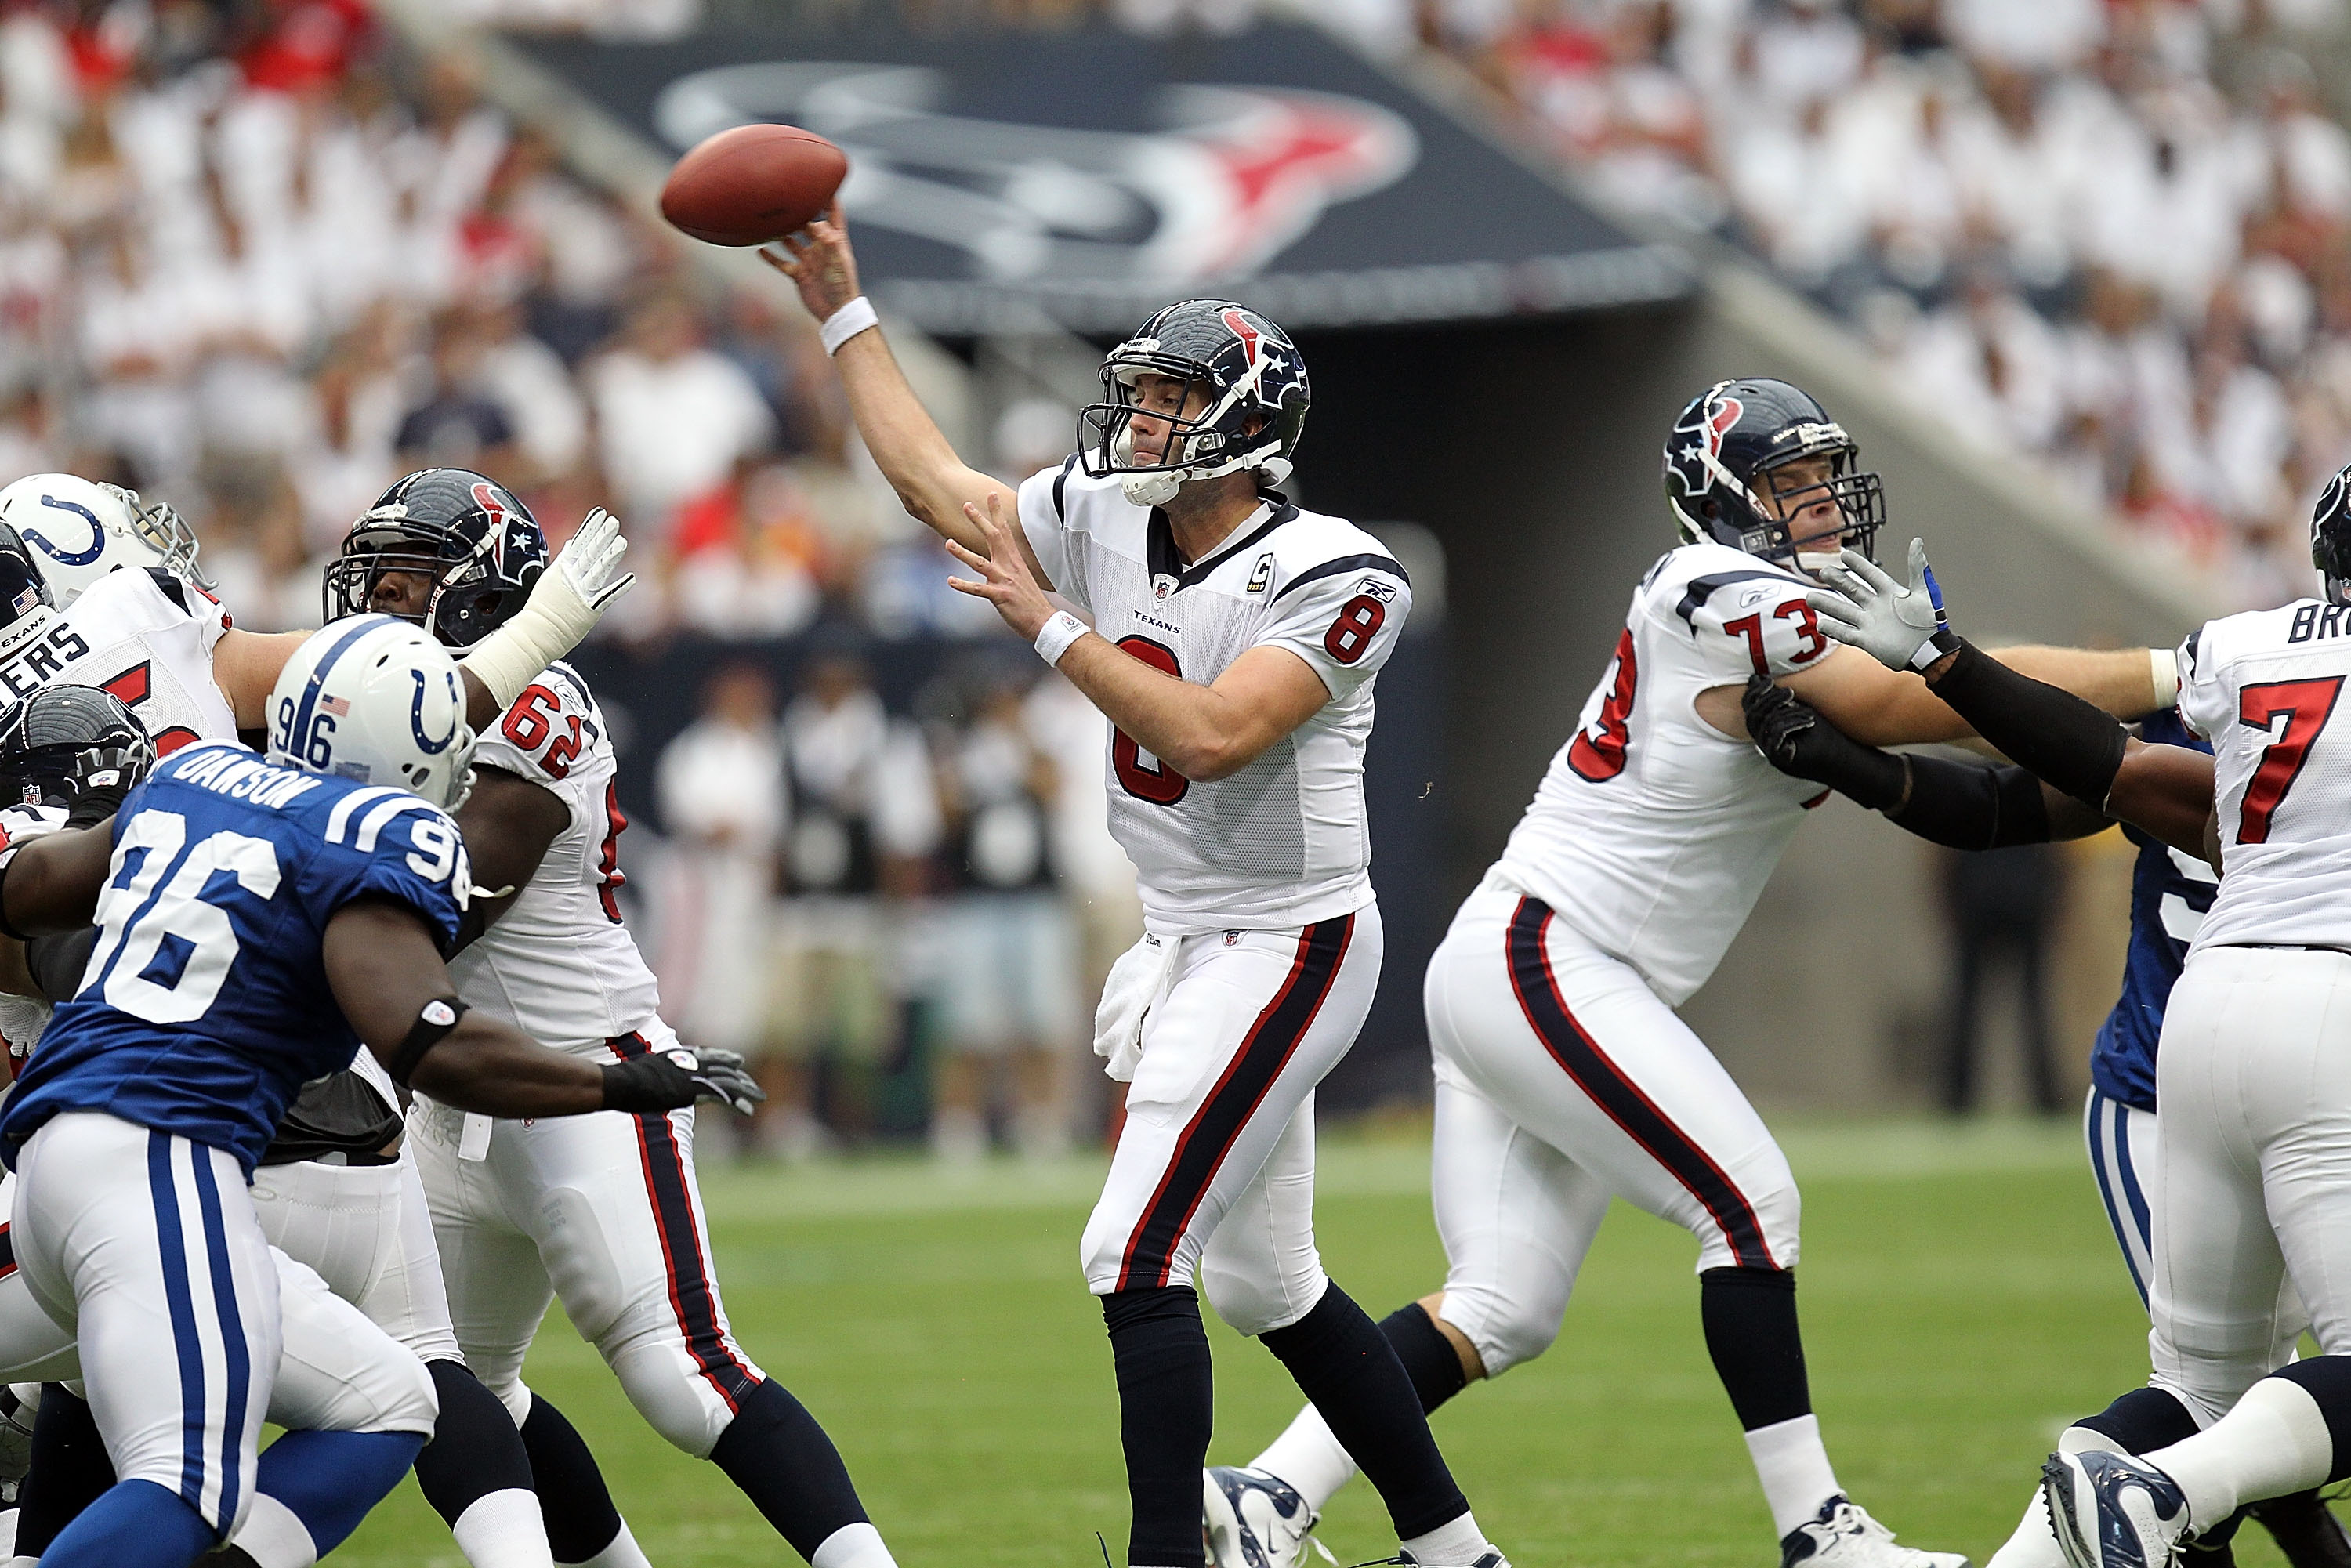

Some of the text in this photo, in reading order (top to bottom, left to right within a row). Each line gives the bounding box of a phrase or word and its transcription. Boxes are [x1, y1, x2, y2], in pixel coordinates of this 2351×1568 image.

[1133, 610, 1181, 634] TEXANS
[1324, 594, 1385, 664] 8
[1722, 598, 1827, 681] 73
[2288, 604, 2351, 644] BR
[275, 697, 336, 769] 96
[502, 684, 582, 780] 62
[2237, 675, 2346, 845] 7
[172, 749, 322, 809] DAWSON
[71, 808, 282, 1024] 96
